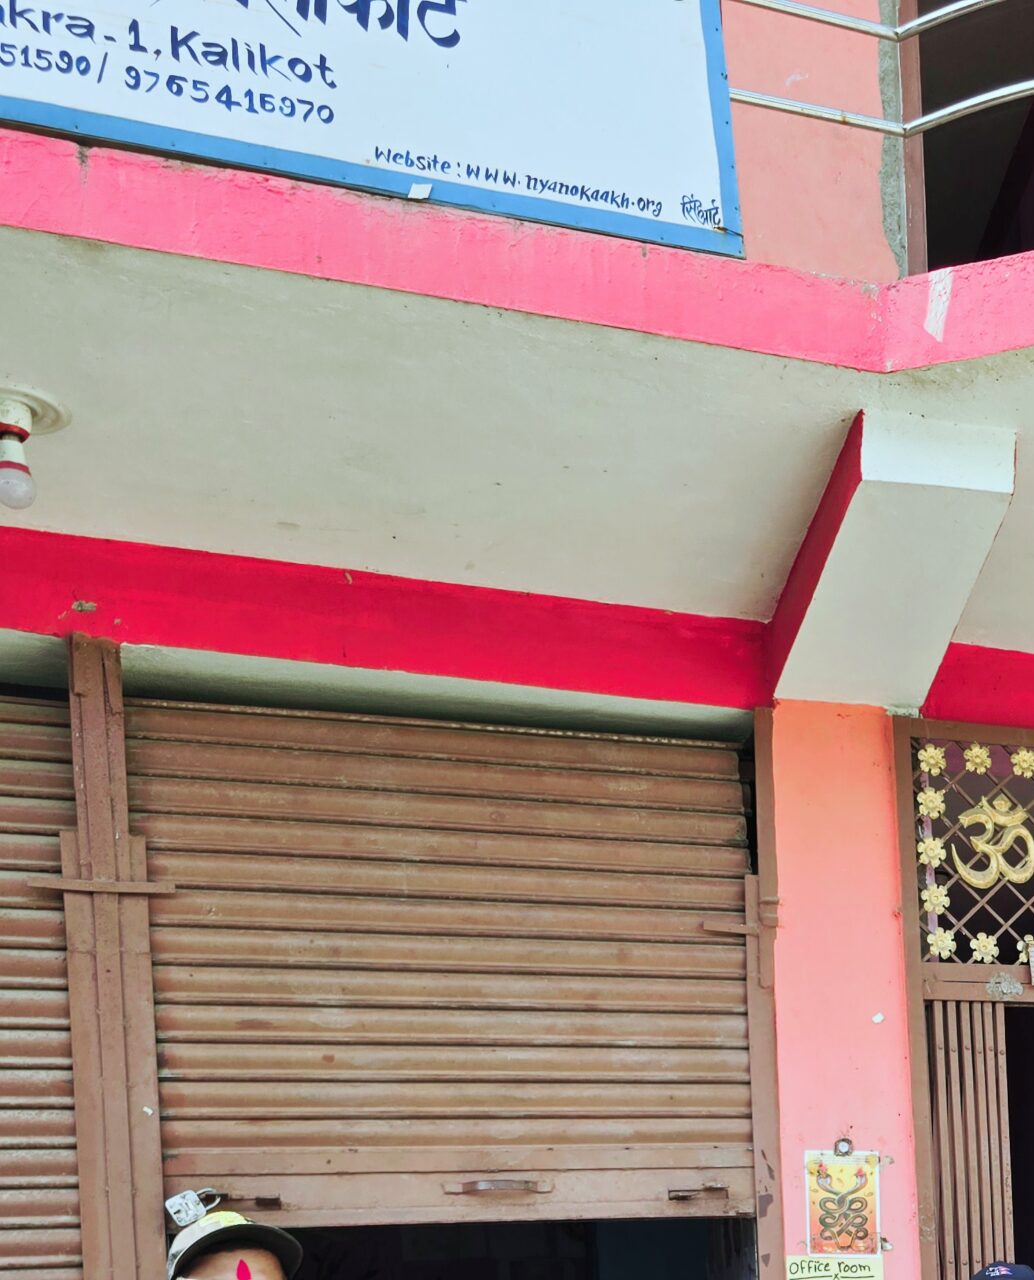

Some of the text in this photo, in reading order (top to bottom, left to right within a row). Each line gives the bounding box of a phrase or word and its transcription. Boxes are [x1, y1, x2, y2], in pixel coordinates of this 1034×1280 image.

[169, 26, 337, 89] Kalikot
[789, 1260, 872, 1275] Office room
